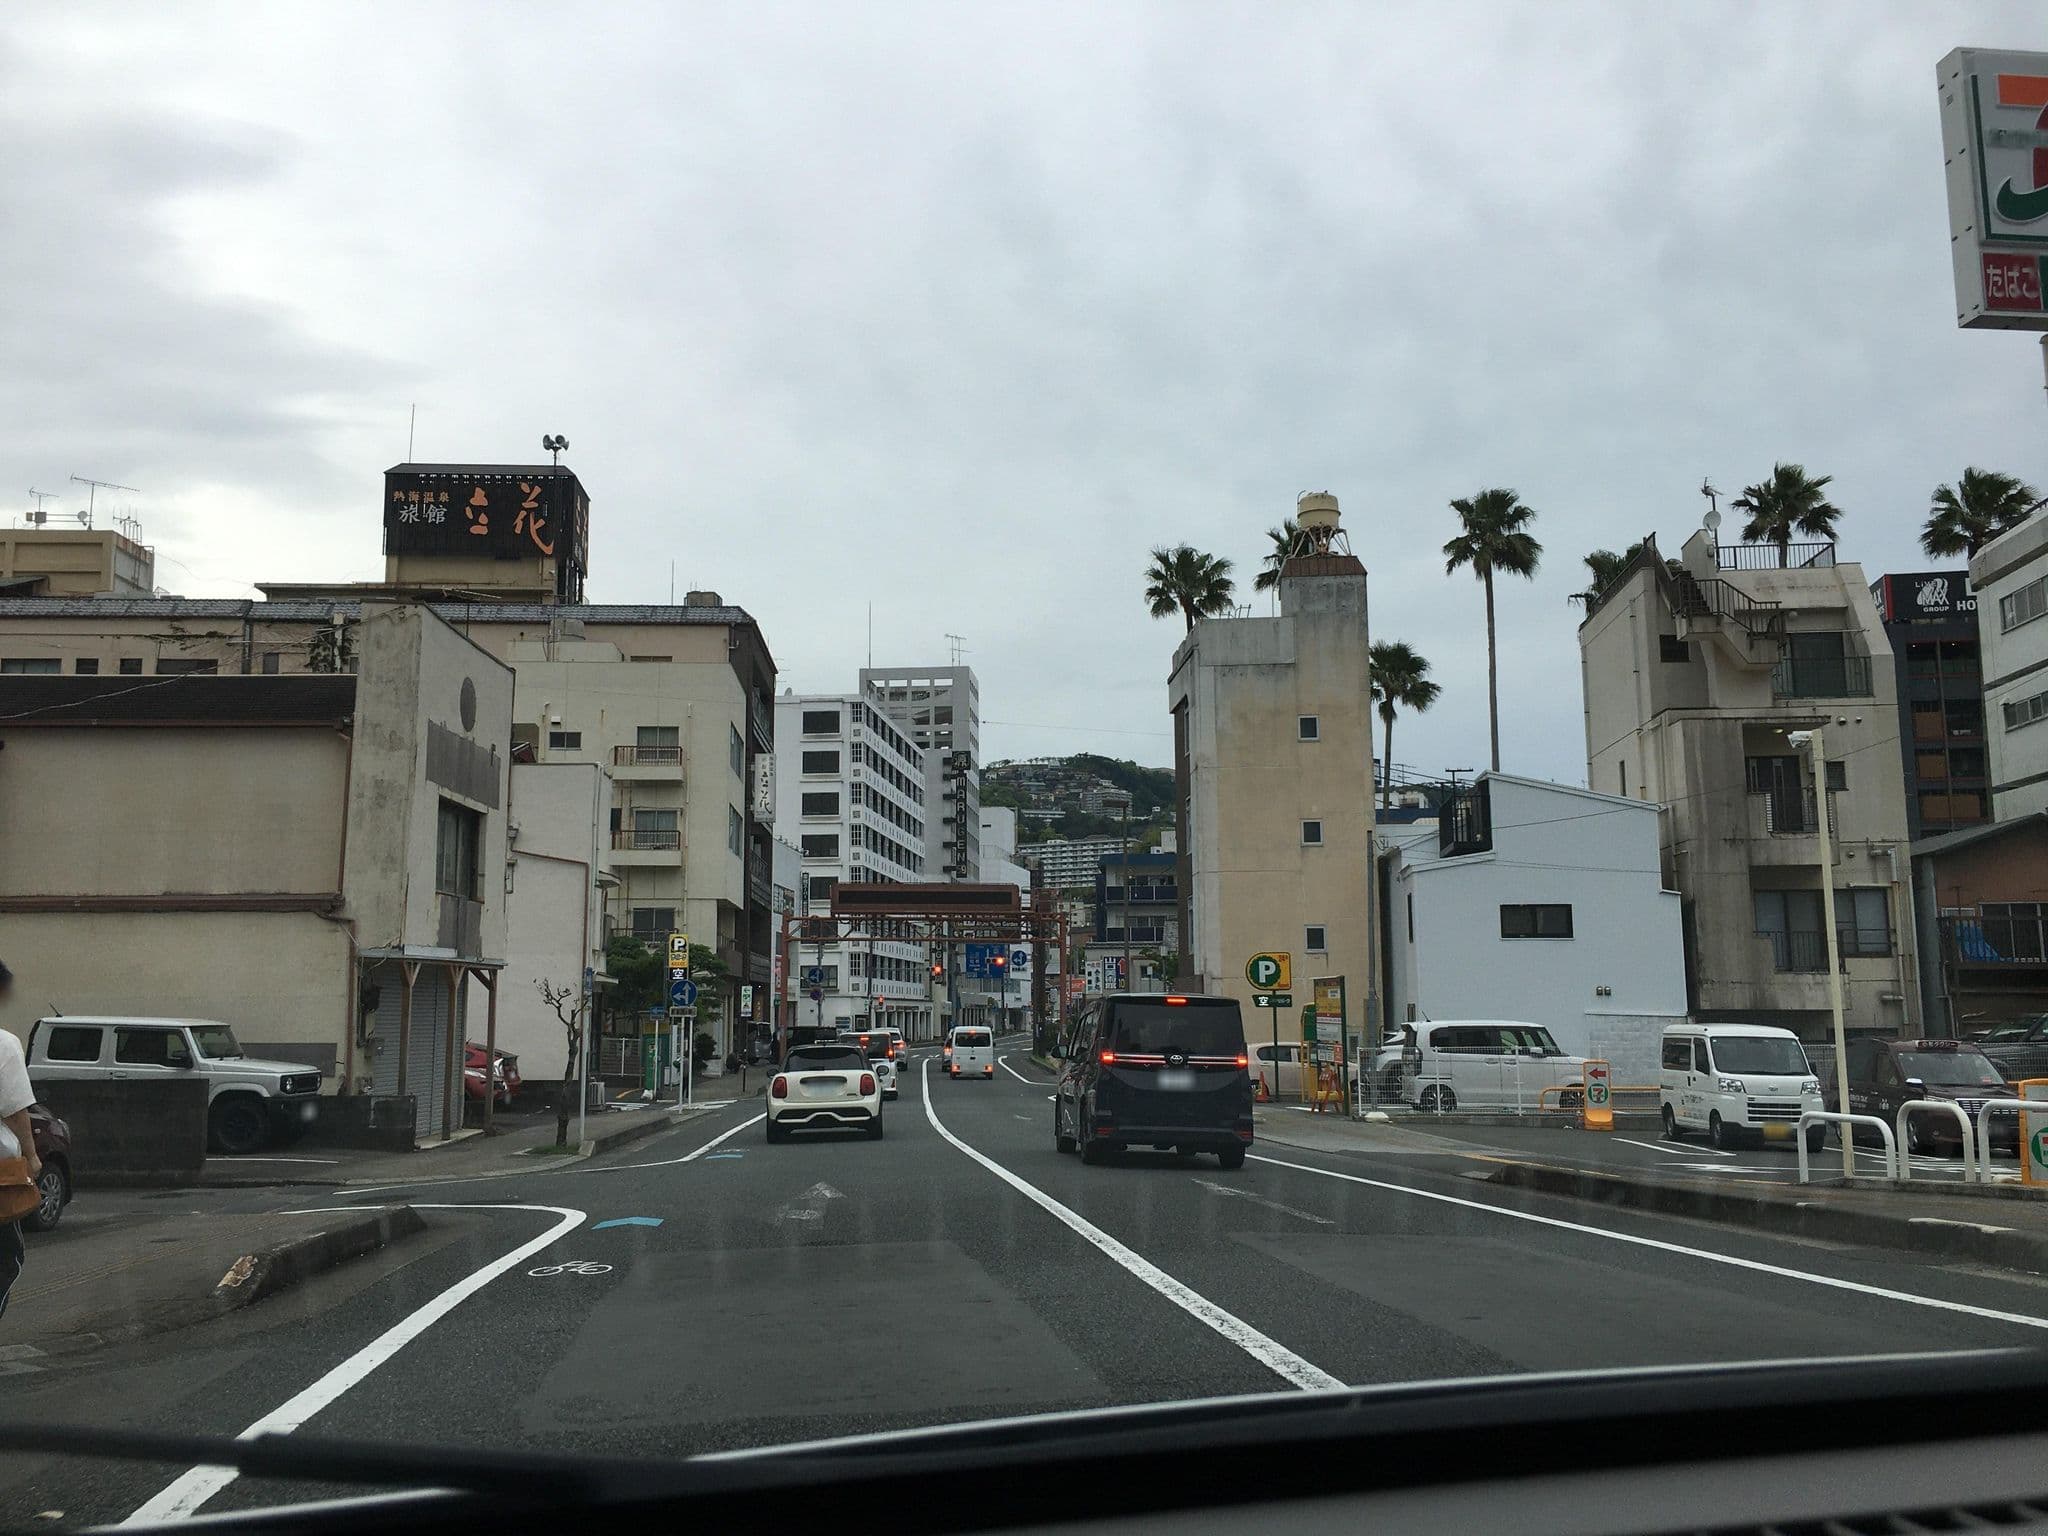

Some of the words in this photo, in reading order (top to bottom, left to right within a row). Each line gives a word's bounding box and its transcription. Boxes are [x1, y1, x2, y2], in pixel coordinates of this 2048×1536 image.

[1986, 264, 2040, 299] たばこ
[399, 504, 448, 524] 旅館
[956, 775, 966, 861] MARUGEN
[673, 938, 686, 951] P
[672, 968, 685, 980] 空
[1258, 960, 1276, 984] P
[1258, 996, 1269, 1007] 空
